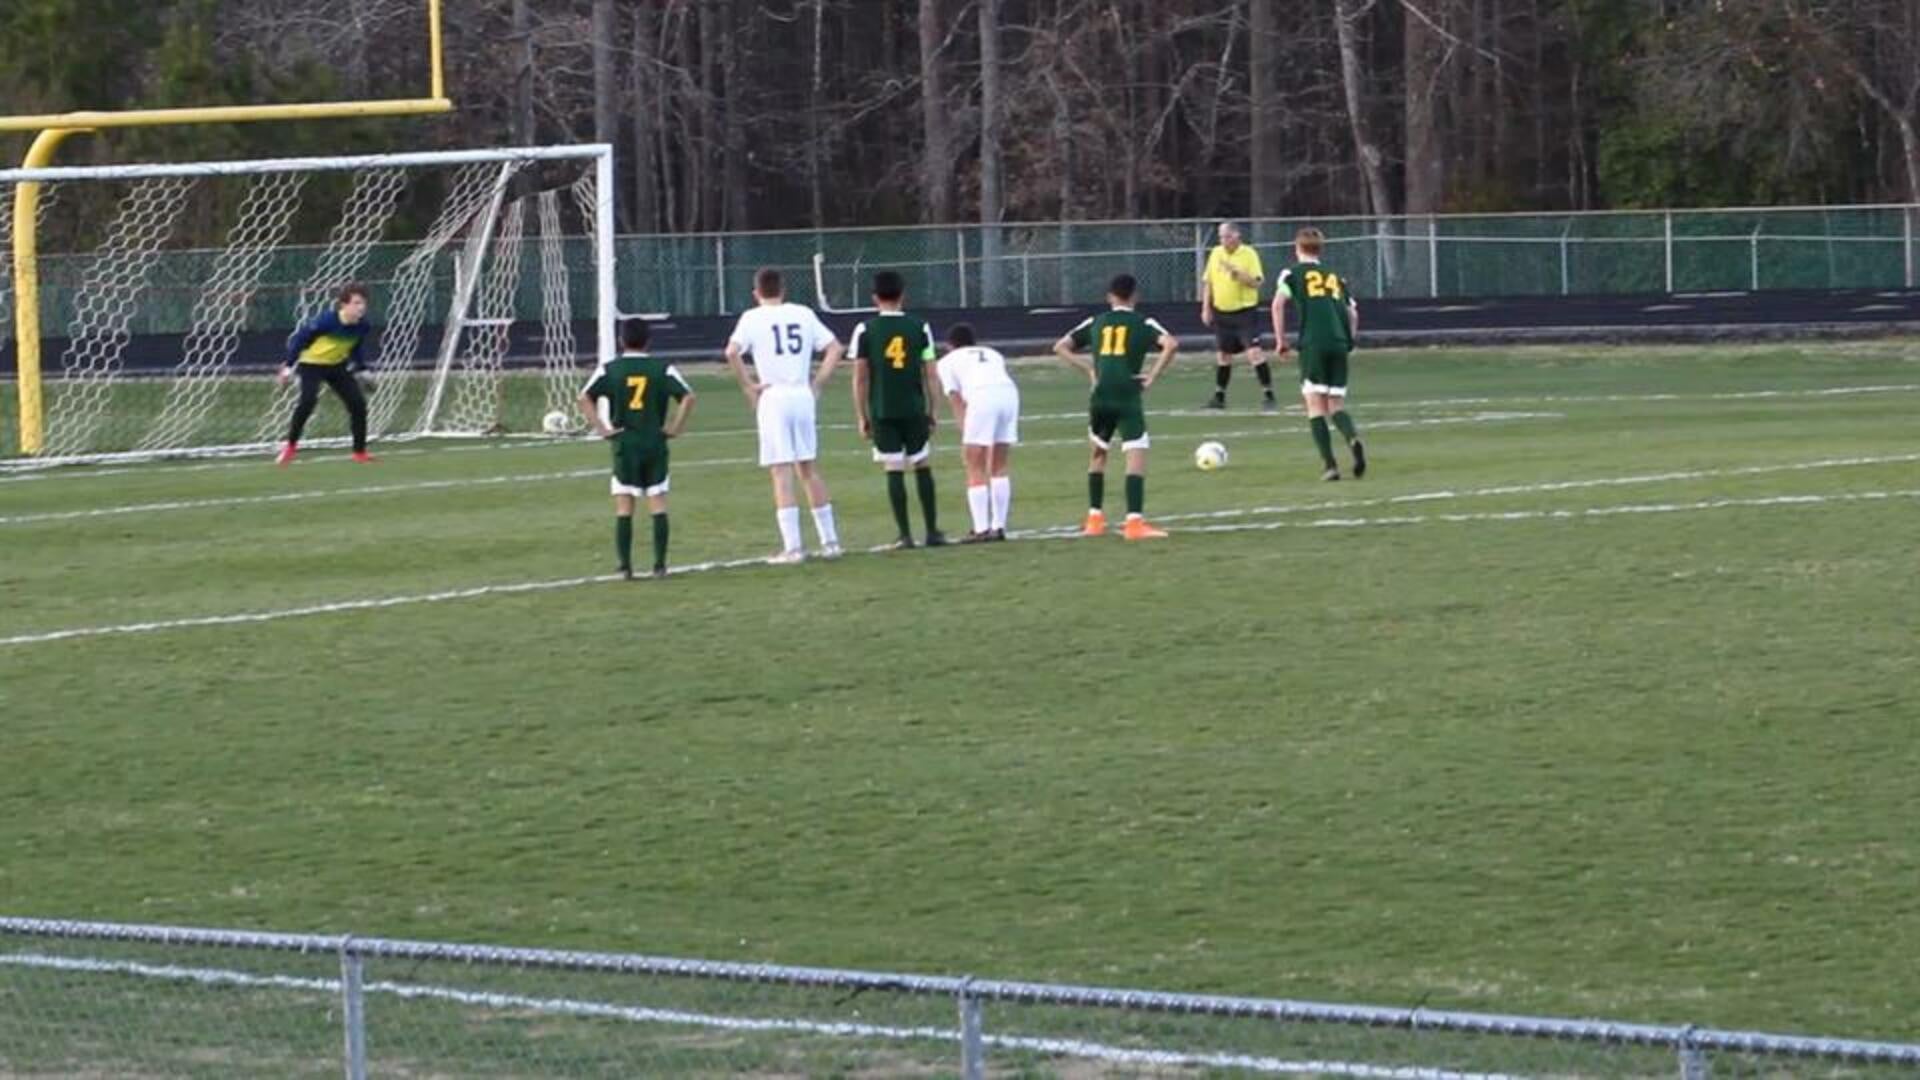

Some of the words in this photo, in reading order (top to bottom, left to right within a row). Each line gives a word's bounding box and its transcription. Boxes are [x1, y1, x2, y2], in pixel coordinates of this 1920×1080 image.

[1304, 269, 1341, 300] 24
[771, 323, 803, 355] 15
[885, 335, 907, 369] 4
[1100, 325, 1127, 356] 11
[626, 375, 648, 410] 7
